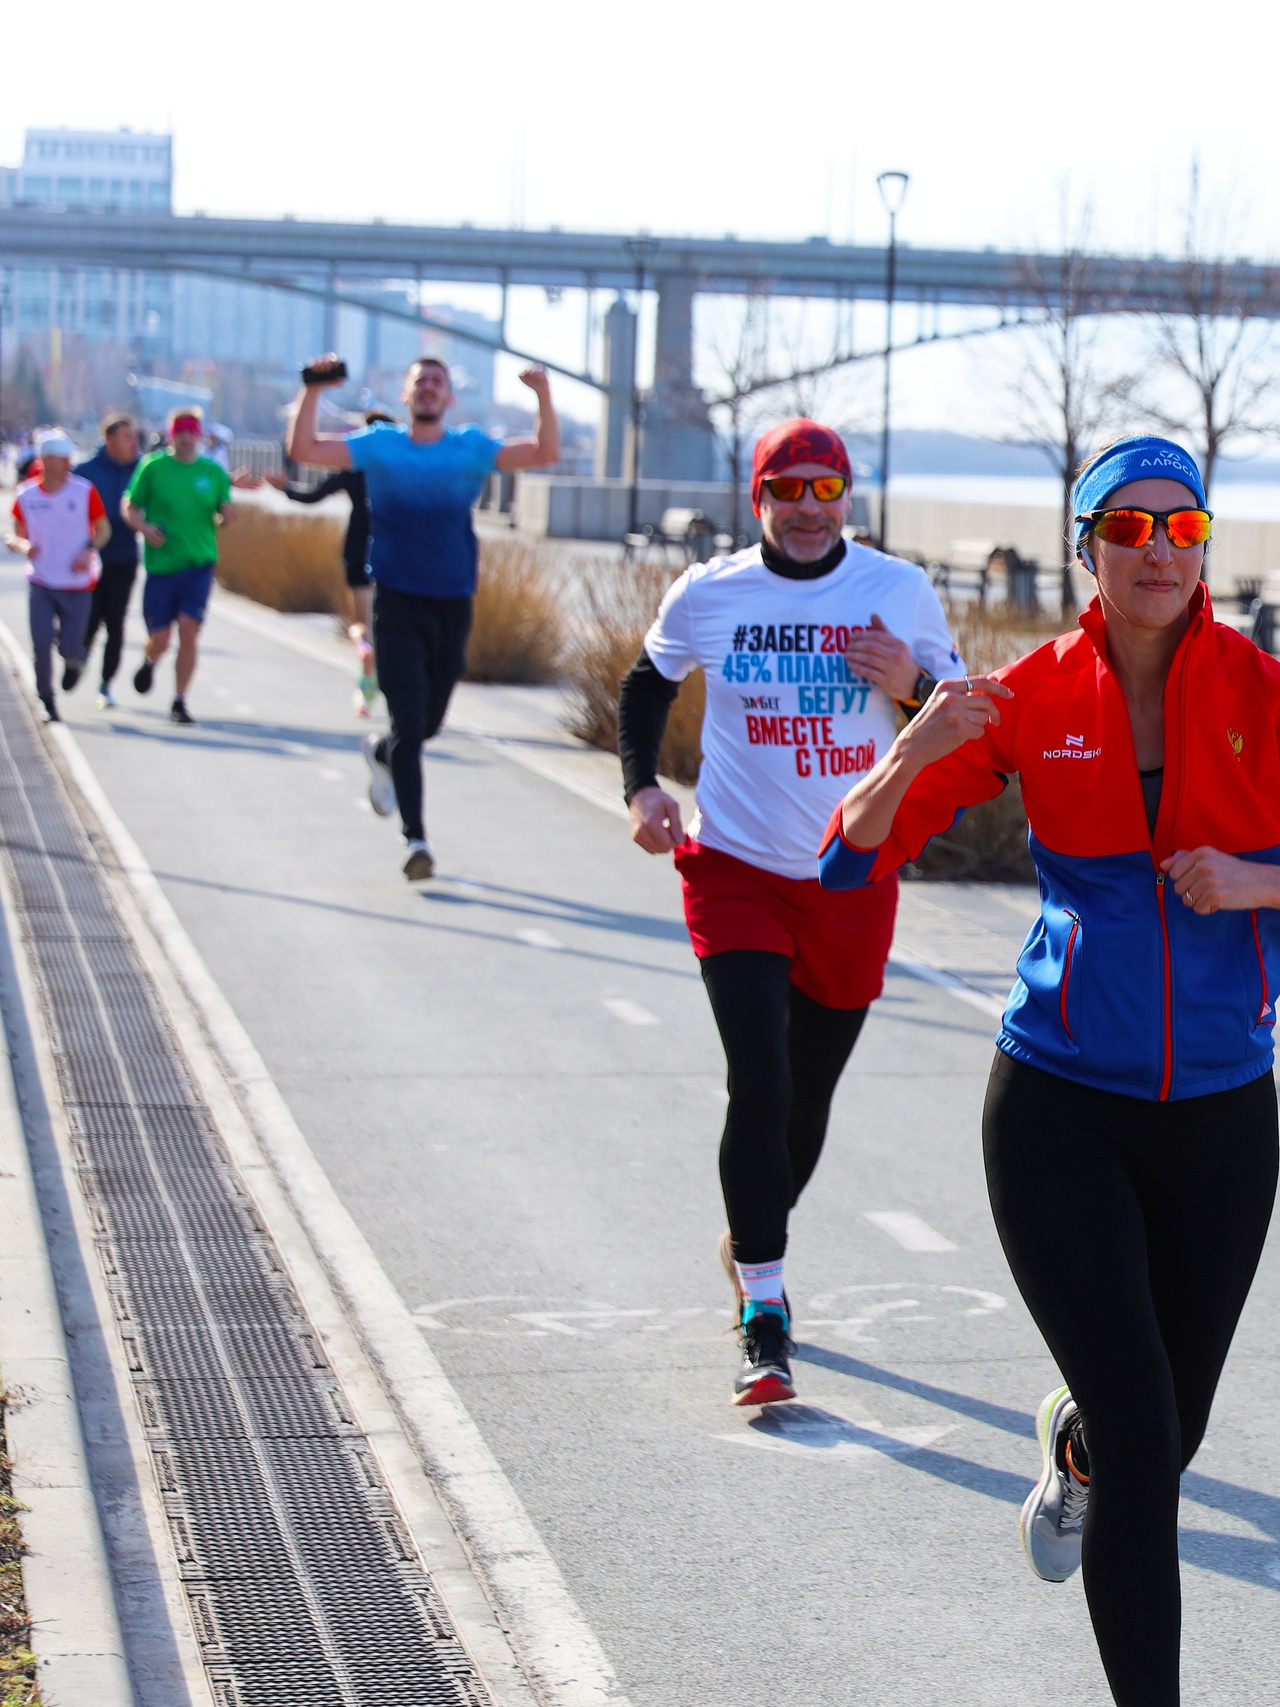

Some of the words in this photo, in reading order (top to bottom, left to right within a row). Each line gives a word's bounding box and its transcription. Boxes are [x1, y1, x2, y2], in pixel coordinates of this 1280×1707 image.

[733, 624, 874, 653] #ЗАБЕГ20
[722, 654, 772, 683] 45%
[798, 686, 871, 715] БЕГУТ
[746, 714, 835, 746] ВМЕСТЕ
[796, 748, 811, 778] С
[815, 739, 877, 777] ТОБОЙ
